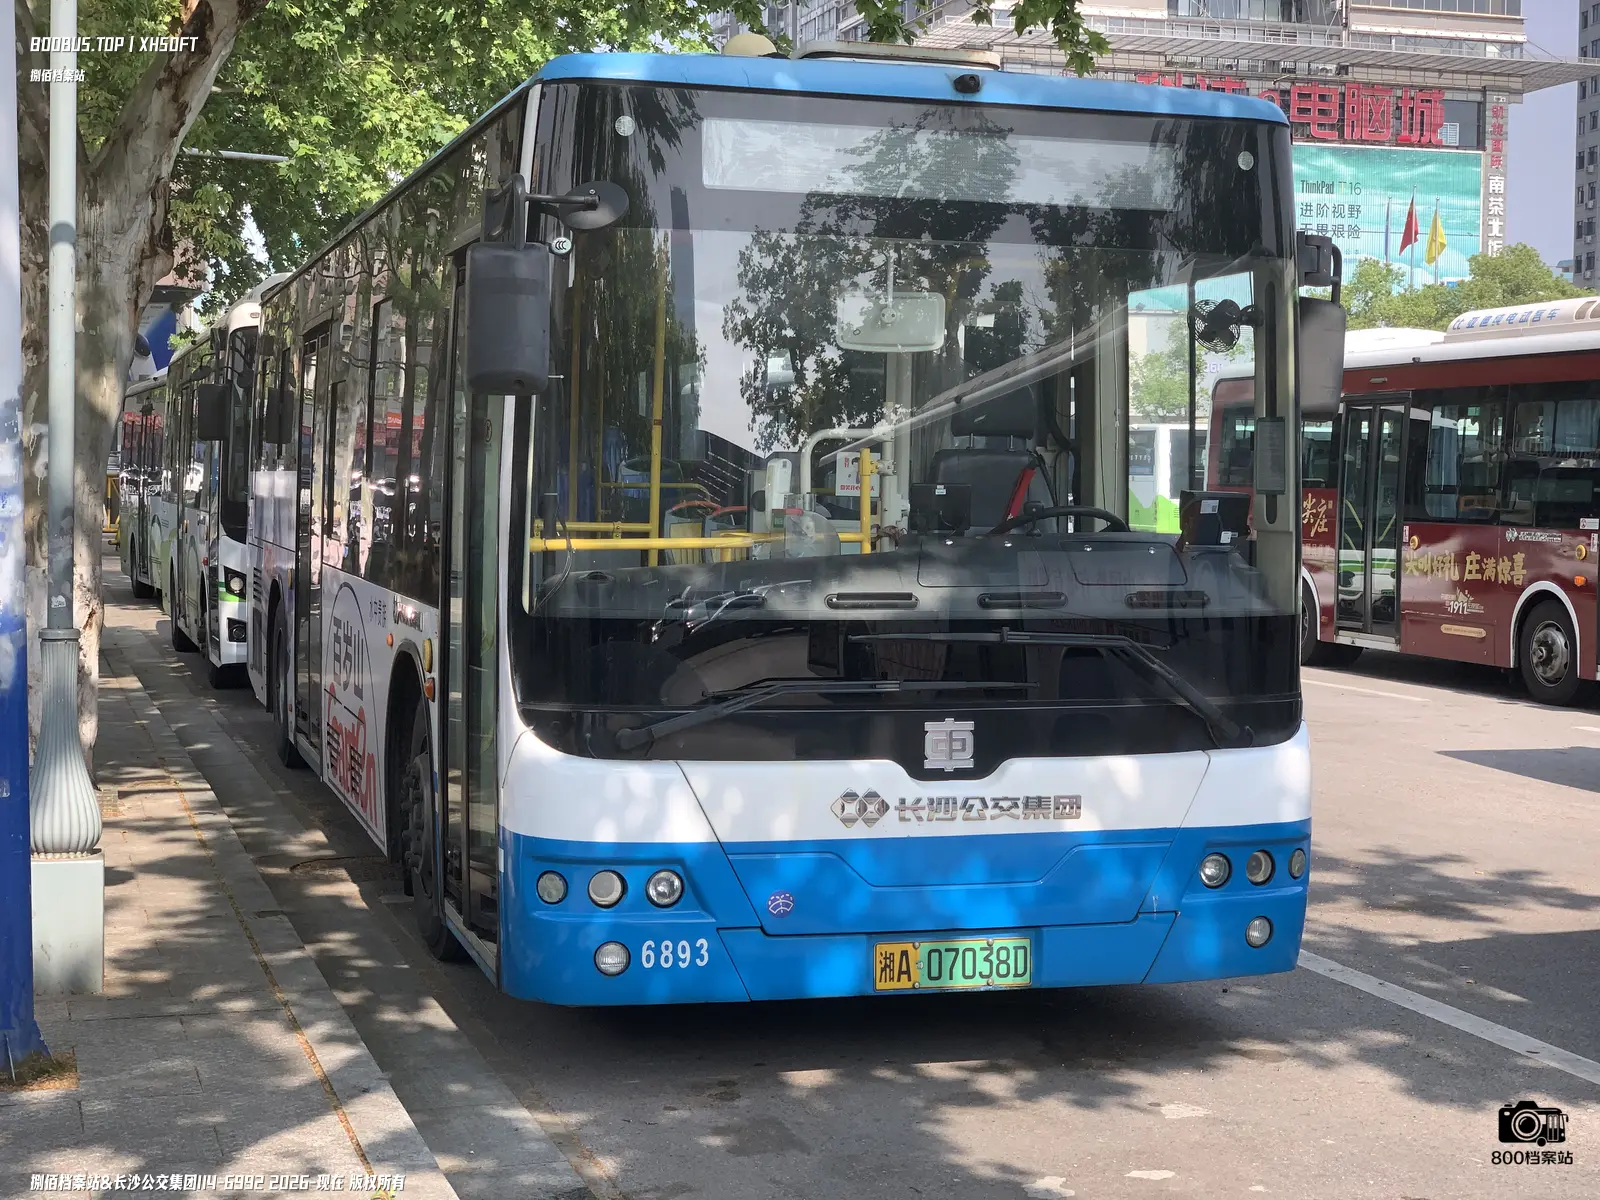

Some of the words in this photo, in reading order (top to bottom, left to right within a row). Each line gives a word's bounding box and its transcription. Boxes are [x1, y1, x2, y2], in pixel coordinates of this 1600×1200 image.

[1300, 180, 1335, 194] ThinkPad
[1300, 202, 1362, 219] 进阶视野
[1300, 223, 1361, 239] 无畏艰险
[1452, 308, 1560, 331] 比亚迪纯电动客车
[1404, 549, 1460, 582] 尖叫好礼
[1463, 550, 1527, 586] 庄满惊喜
[333, 615, 364, 702] 百岁山
[894, 794, 1082, 822] 长沙公交集团
[641, 938, 709, 969] 6893
